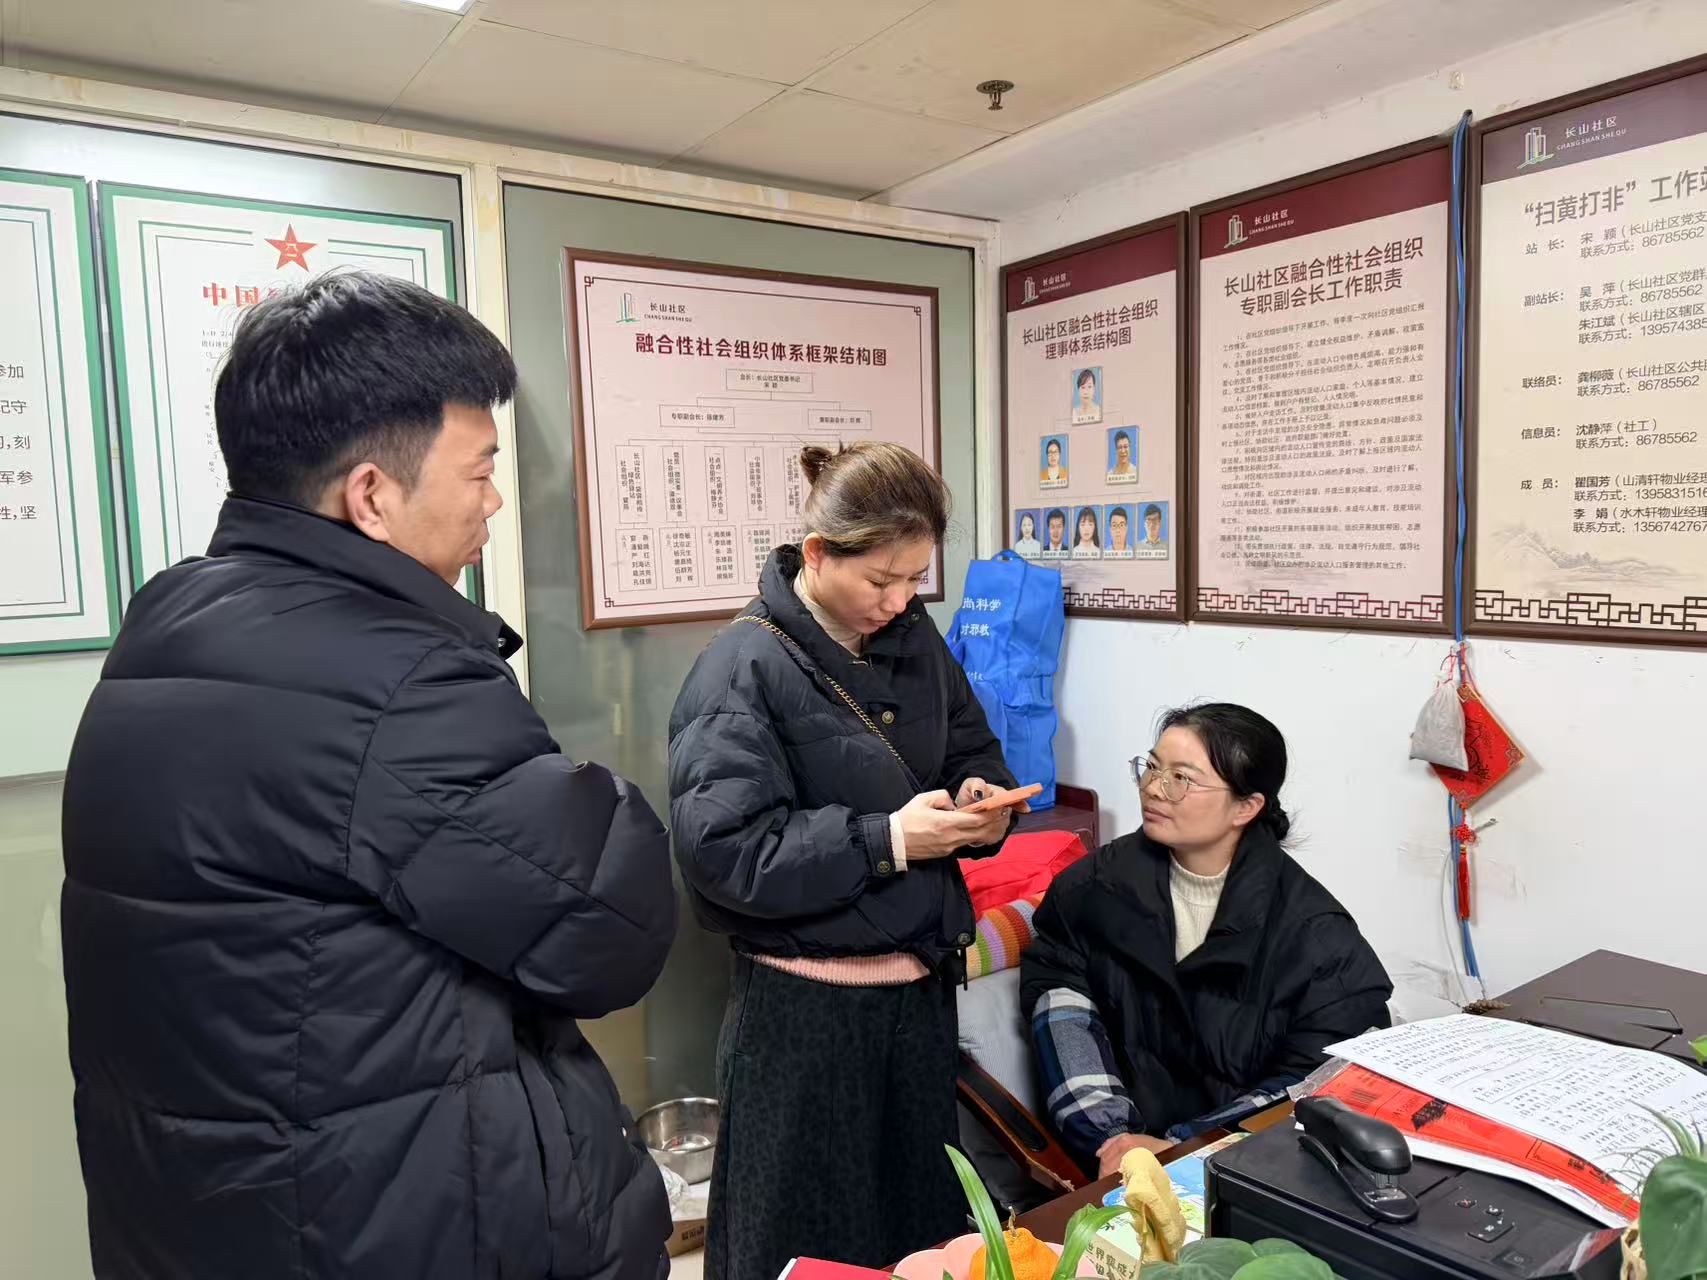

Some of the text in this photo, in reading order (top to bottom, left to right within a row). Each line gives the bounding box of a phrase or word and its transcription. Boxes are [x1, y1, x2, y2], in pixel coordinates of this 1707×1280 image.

[1565, 116, 1617, 138] 长山社区
[1254, 209, 1289, 226] 长山社区
[1224, 236, 1424, 298] 长山社区融合性社会组织
[1240, 268, 1403, 317] 专职副会长工作职责
[1523, 291, 1564, 308] 副站长：
[650, 302, 687, 314] 长山社区
[1023, 299, 1159, 346] 长山社区融合性社会组织
[635, 332, 887, 367] 融合性社会组织体系框架结构图
[1045, 327, 1132, 361] 理事体系结构图
[1522, 375, 1562, 389] 联络员：
[1577, 359, 1707, 384] 龚柳薇（长山社区公共
[1521, 427, 1561, 440] 信息员：
